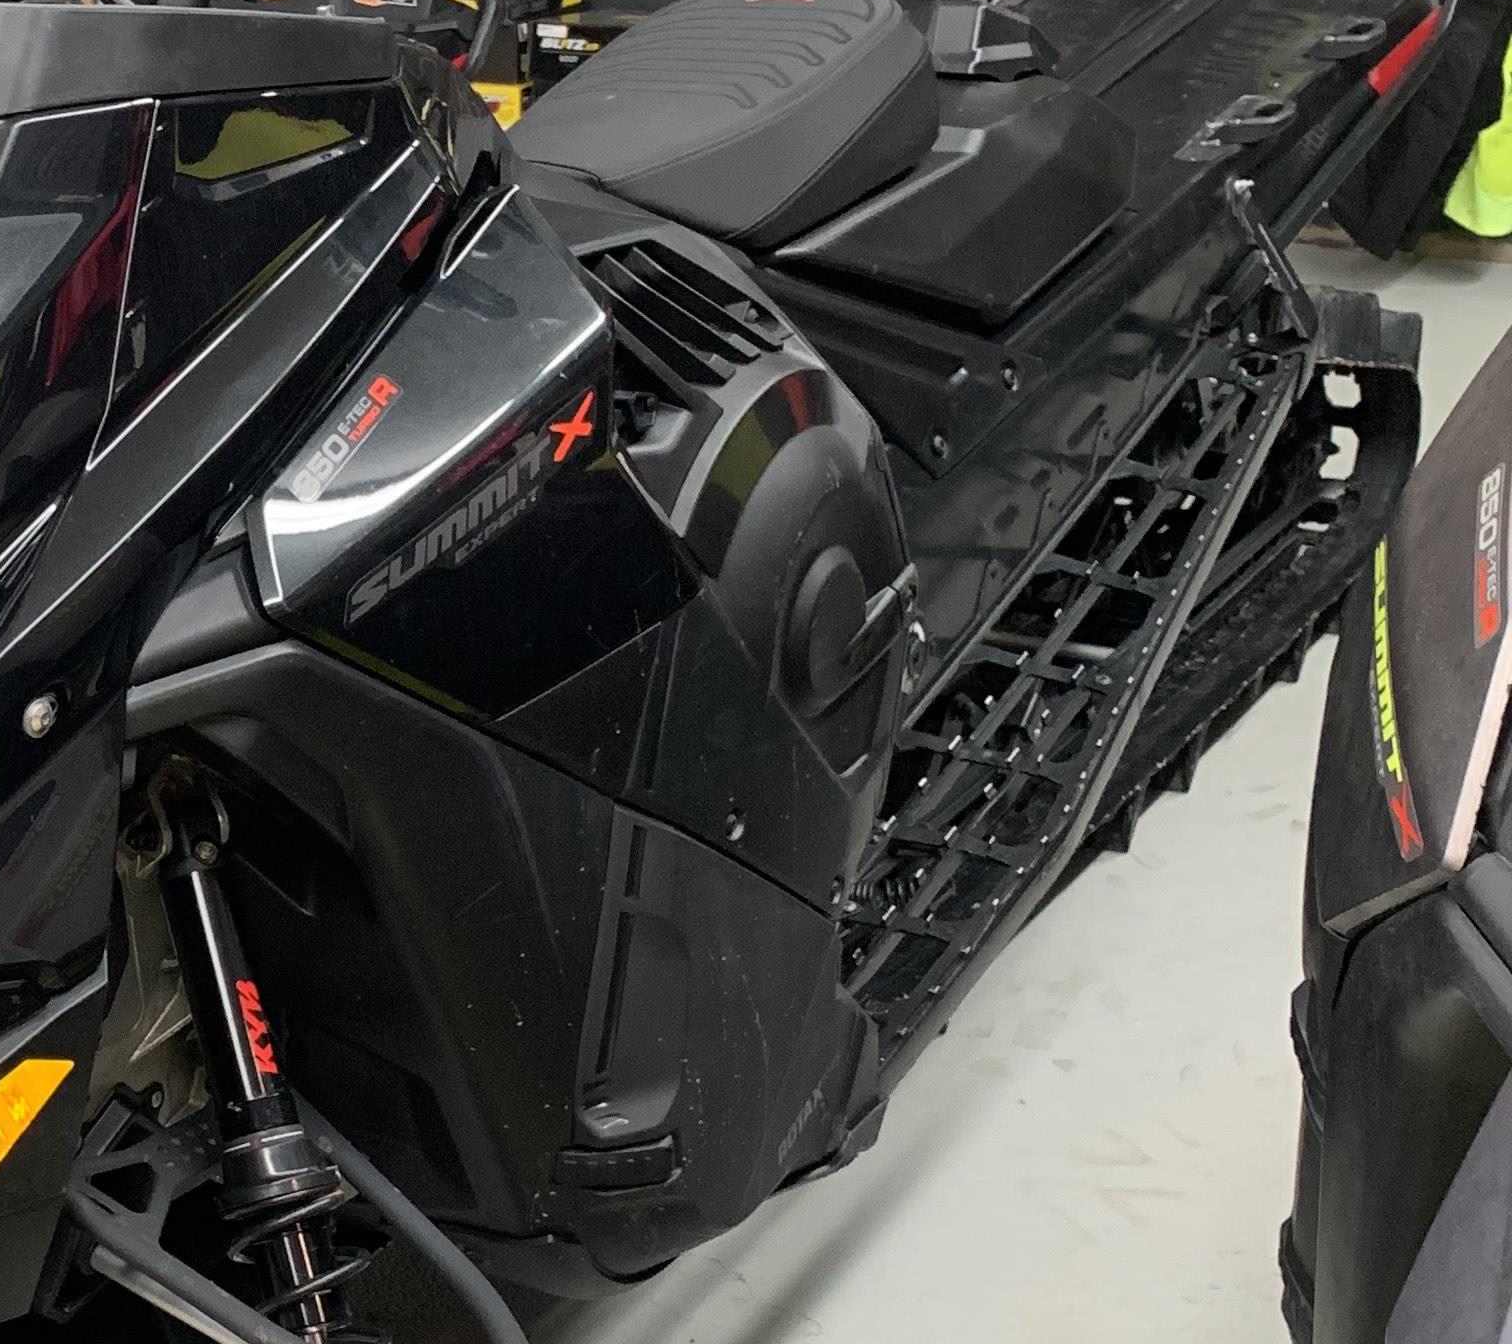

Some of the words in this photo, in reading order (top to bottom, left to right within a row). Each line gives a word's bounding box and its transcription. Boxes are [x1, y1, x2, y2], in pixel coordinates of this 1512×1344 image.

[292, 434, 350, 504] 850
[337, 396, 372, 436] E-TEC
[368, 376, 399, 407] R
[349, 435, 551, 625] SUMMIT
[550, 391, 594, 462] X
[1479, 468, 1501, 551] 850
[1374, 540, 1404, 783] SUMMIT
[235, 980, 279, 1073] KYB
